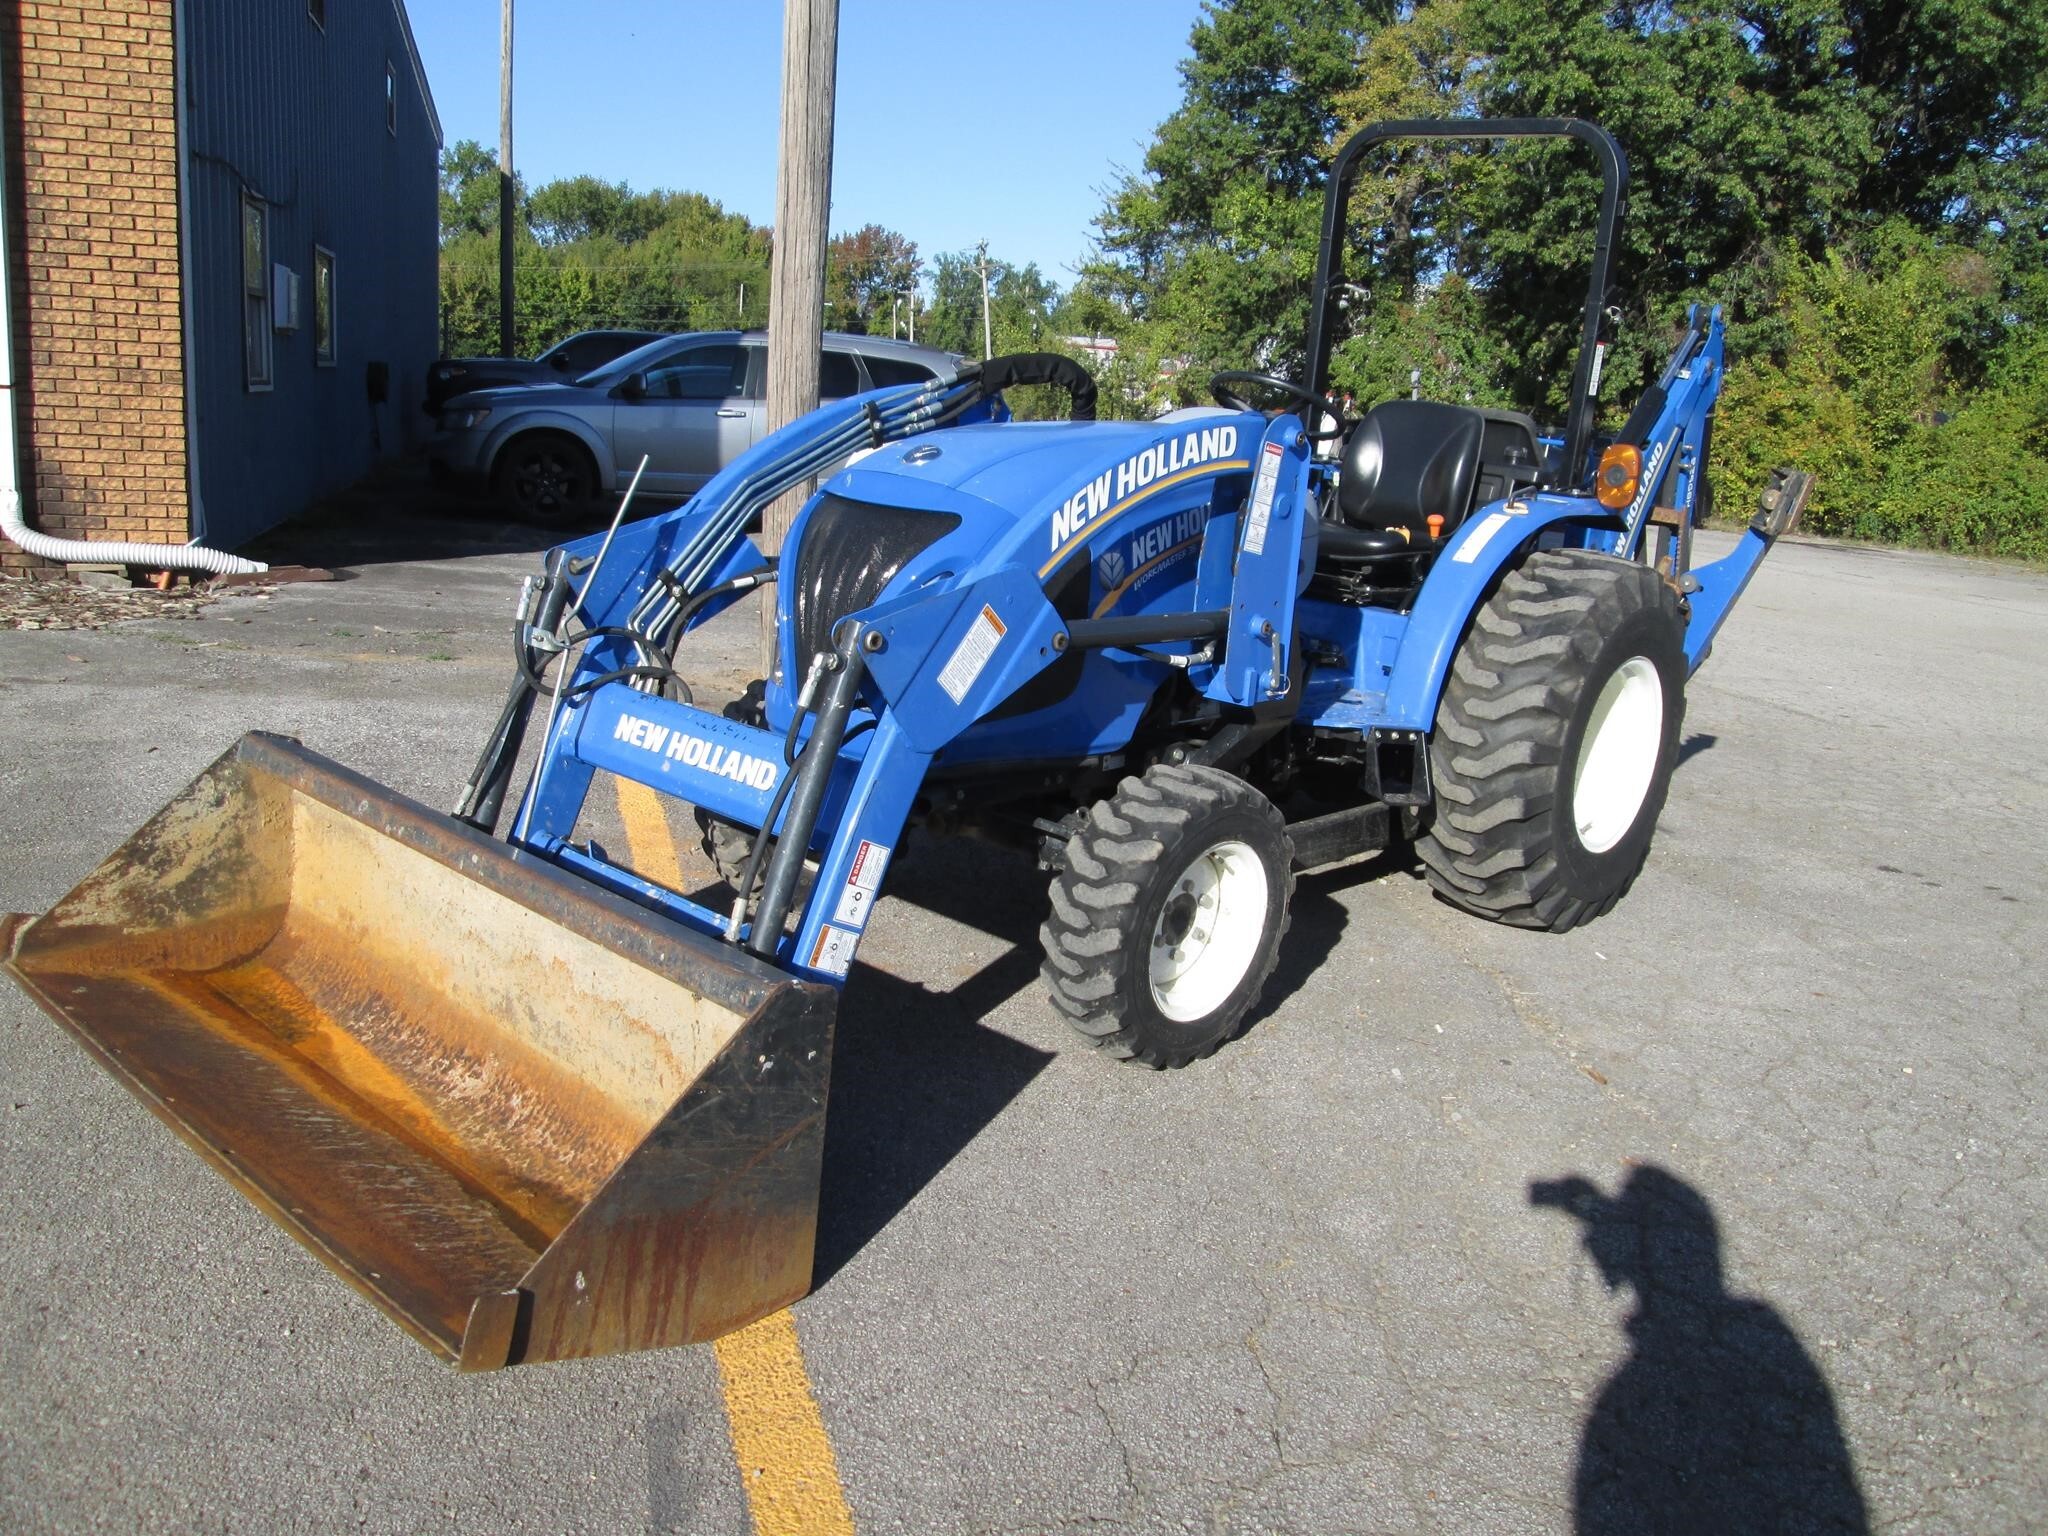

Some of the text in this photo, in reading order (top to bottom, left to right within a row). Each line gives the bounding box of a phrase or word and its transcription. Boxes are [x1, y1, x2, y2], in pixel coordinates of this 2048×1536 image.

[1051, 426, 1237, 553] NEW HOLLAND
[1132, 522, 1174, 570] NEW
[613, 713, 777, 791] NEW HOLLAND
[853, 845, 869, 876] DANGER
